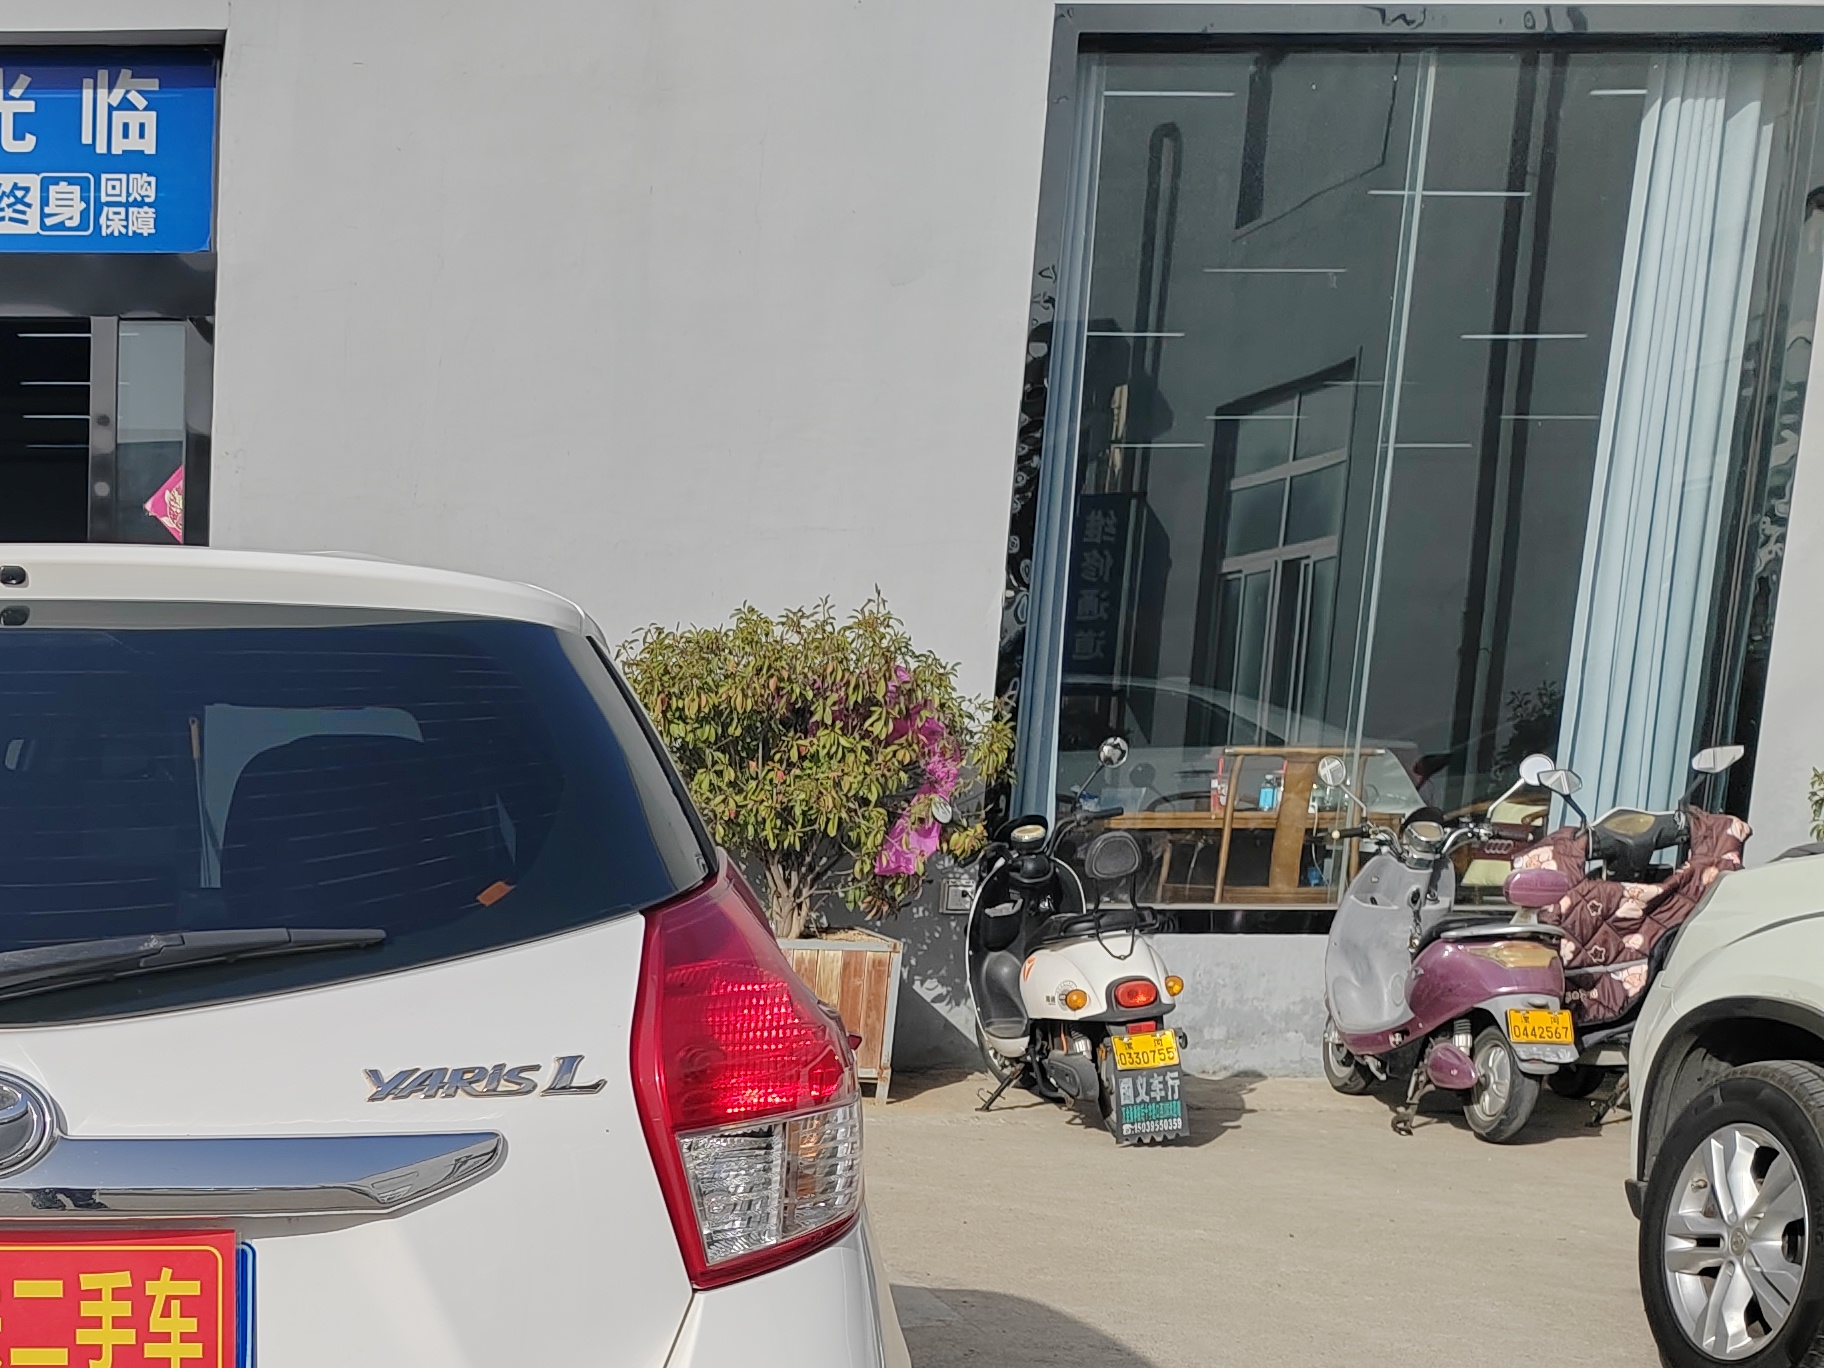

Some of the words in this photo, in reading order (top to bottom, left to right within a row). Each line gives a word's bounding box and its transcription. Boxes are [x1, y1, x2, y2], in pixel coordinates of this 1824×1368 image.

[100, 172, 156, 204] 回购
[98, 206, 156, 238] 保障
[1513, 1024, 1569, 1040] 0442567
[1119, 1046, 1175, 1066] 0330755
[364, 1062, 542, 1102] YARIS
[540, 1054, 608, 1098] L
